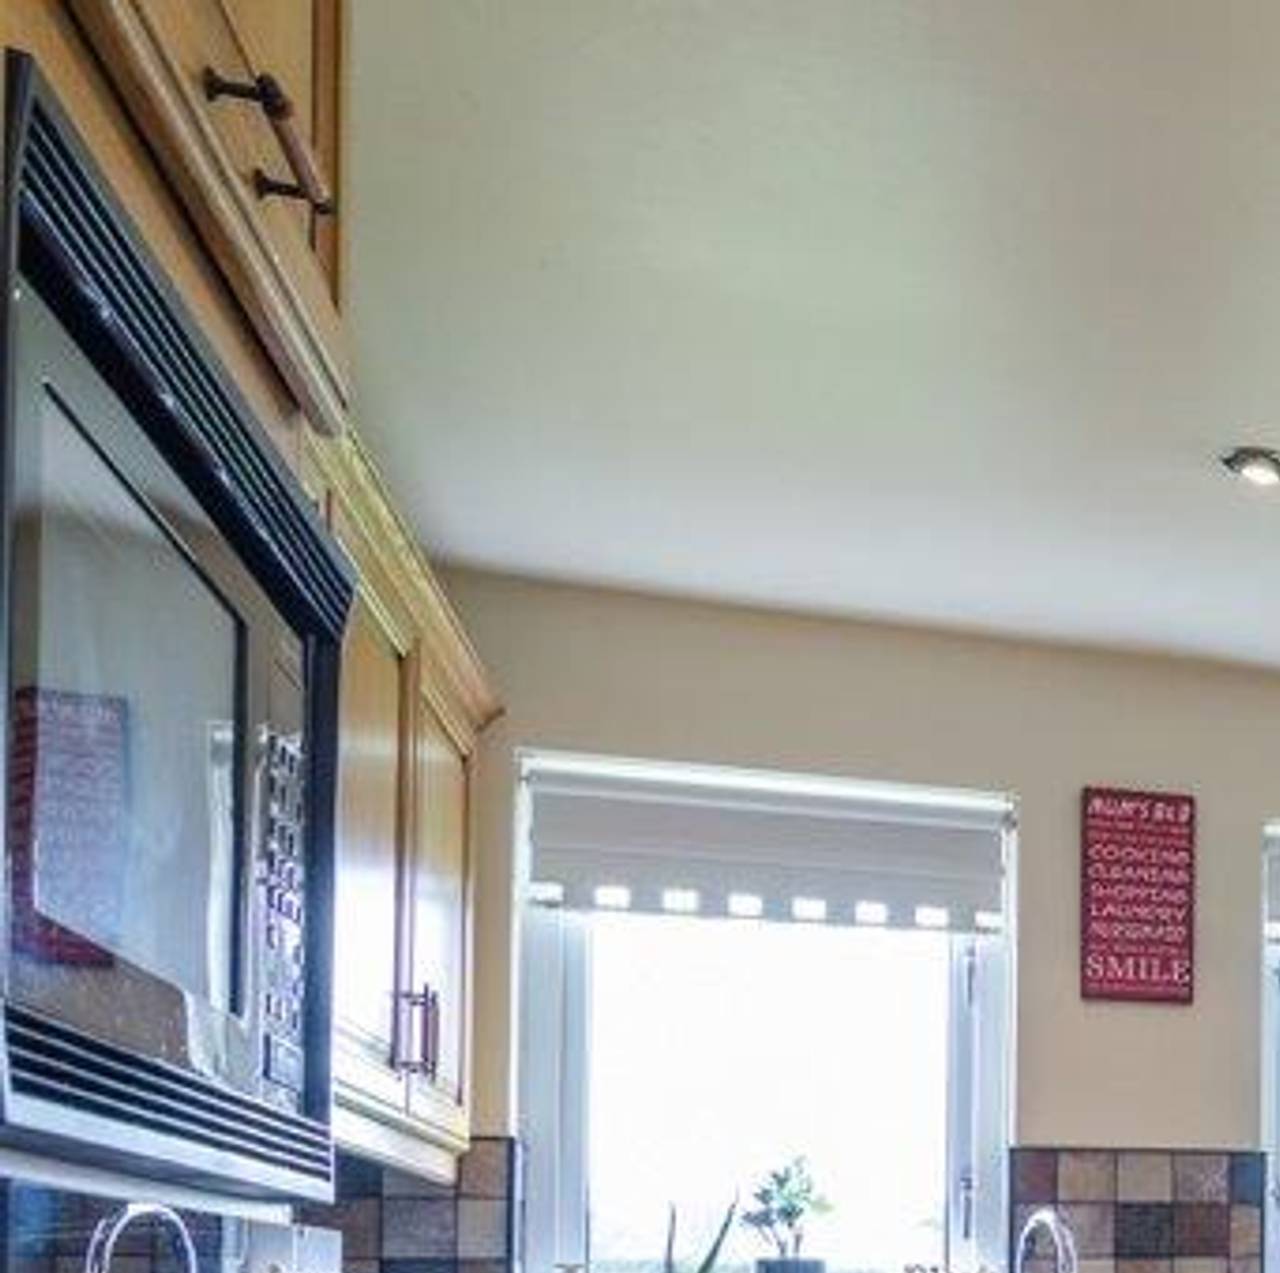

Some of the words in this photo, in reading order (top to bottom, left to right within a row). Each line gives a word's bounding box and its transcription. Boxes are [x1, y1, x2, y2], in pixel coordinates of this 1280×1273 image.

[1087, 843, 1191, 867] COOKING
[1087, 862, 1191, 886] CLEANING
[1090, 902, 1188, 924] LAUNDRY
[1086, 954, 1191, 983] SMILE
